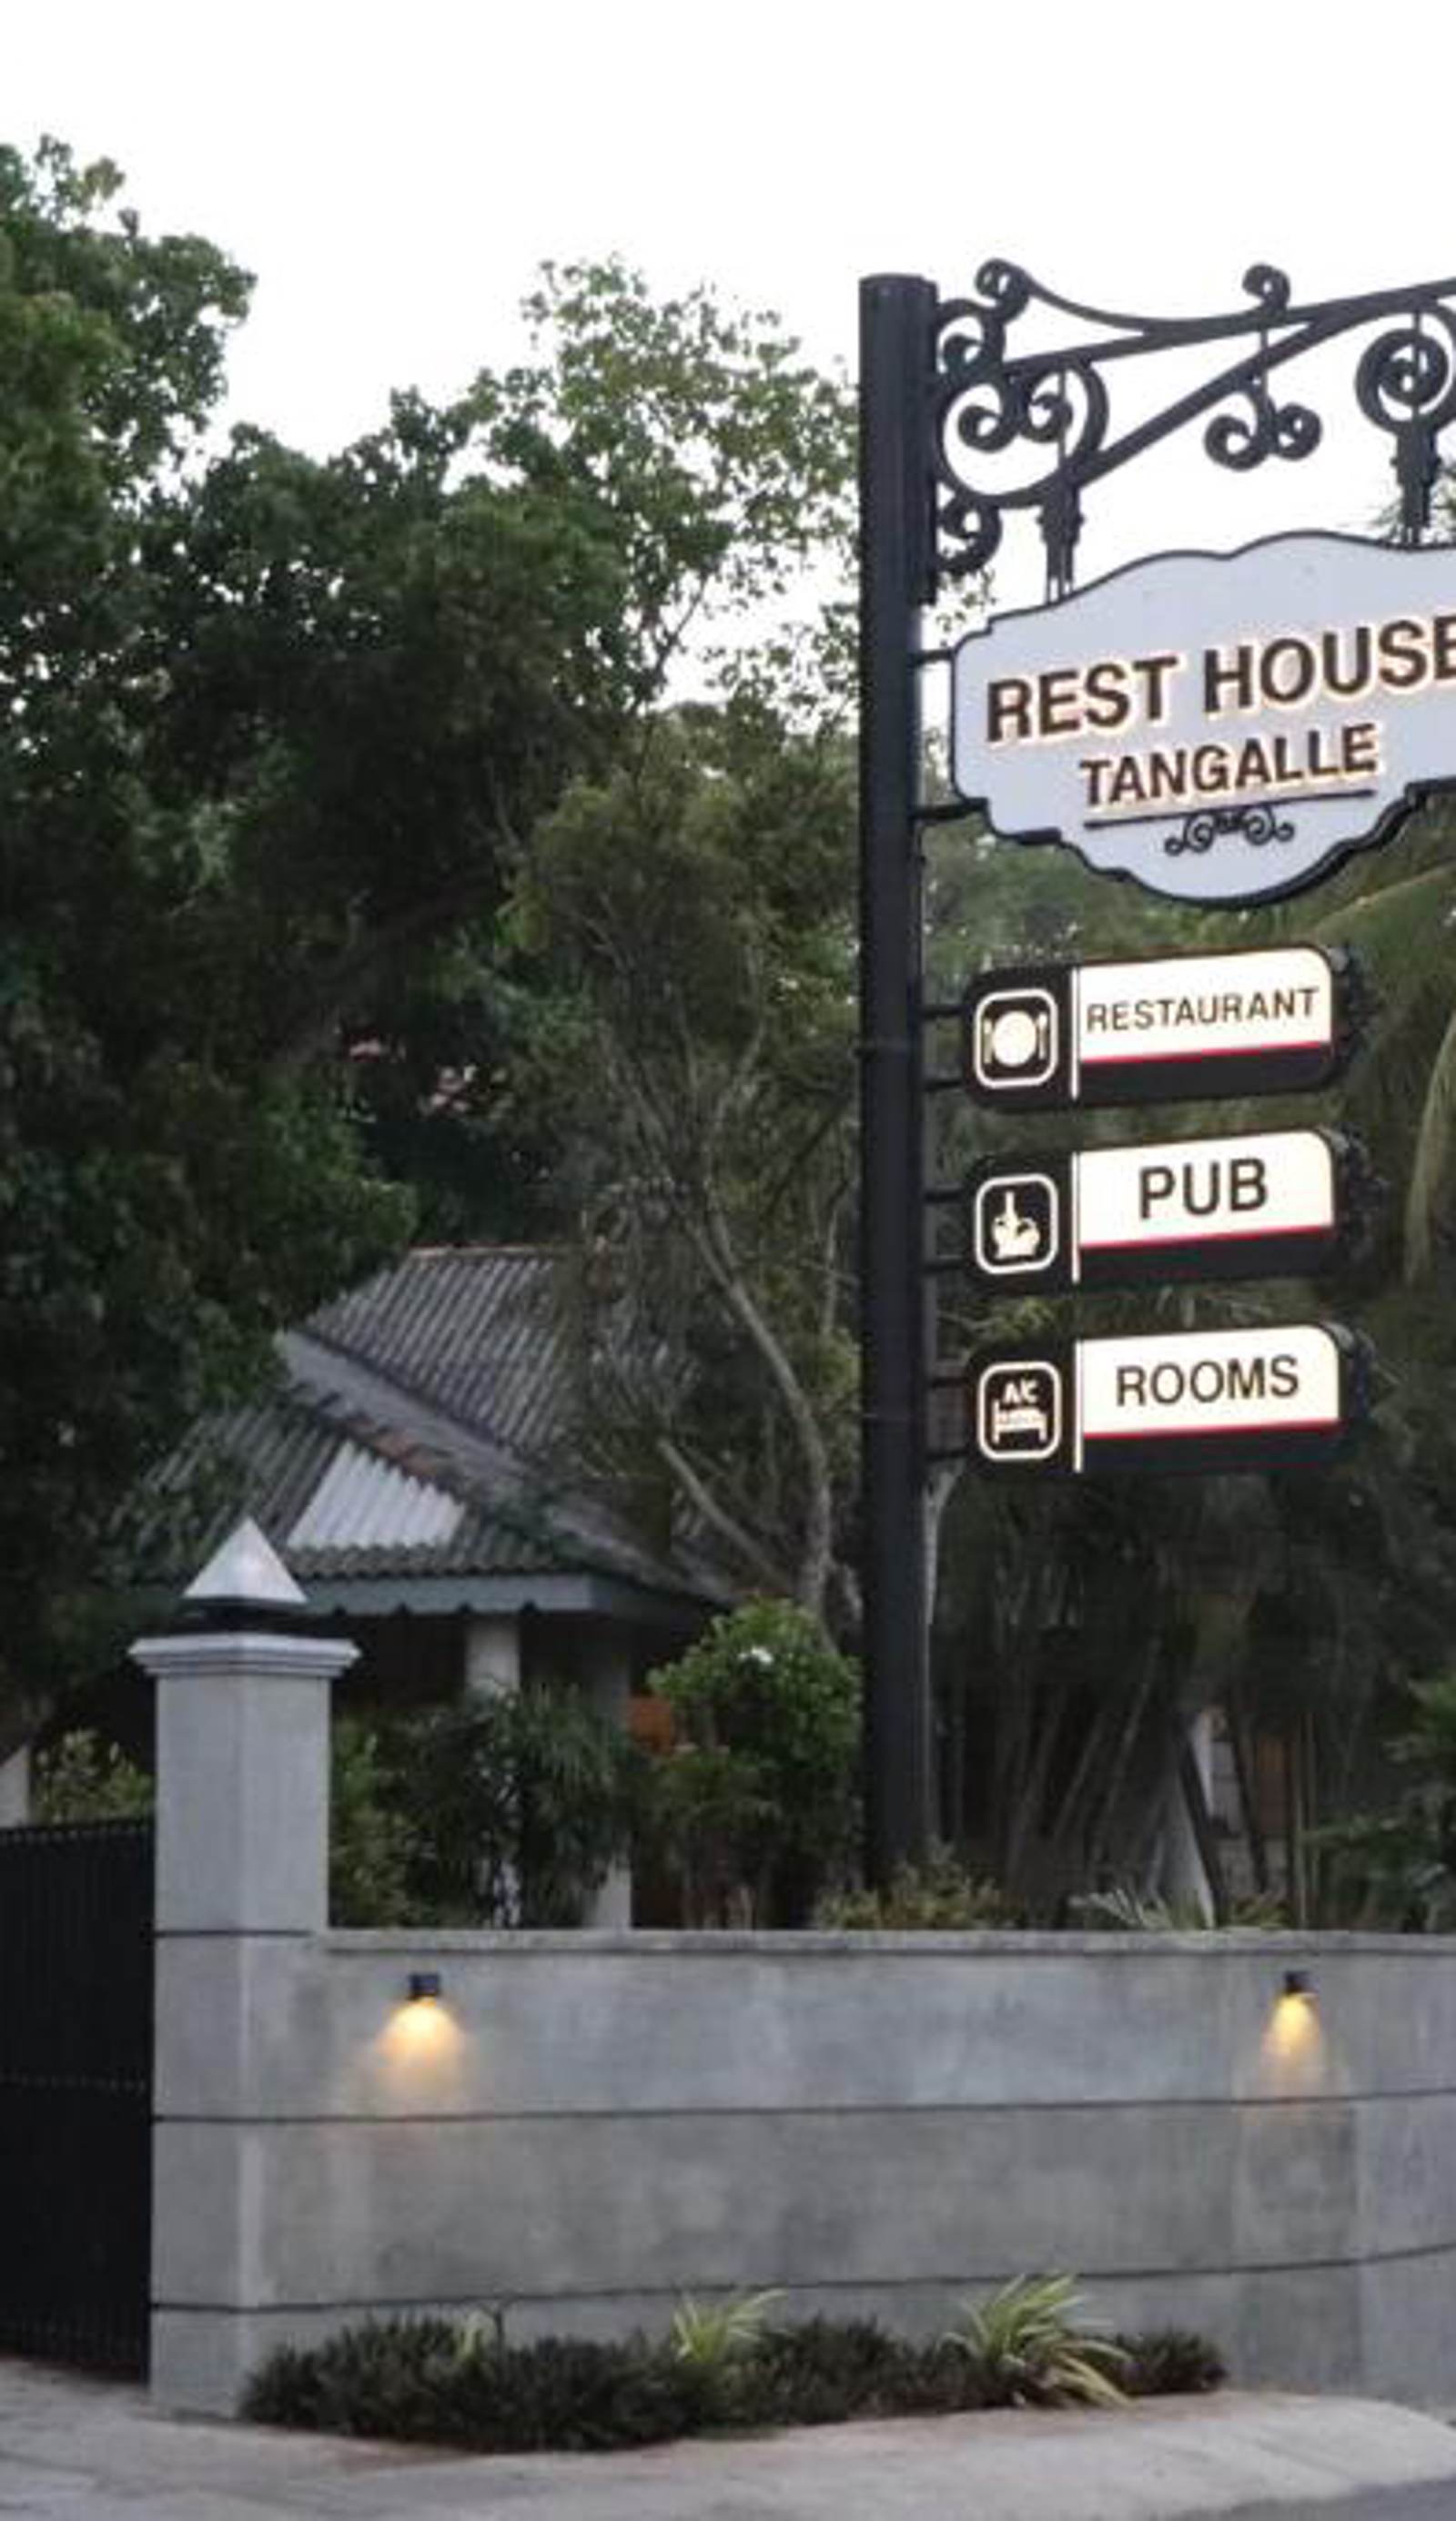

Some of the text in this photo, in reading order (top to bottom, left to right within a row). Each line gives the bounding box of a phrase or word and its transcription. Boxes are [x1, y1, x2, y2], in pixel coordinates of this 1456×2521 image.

[987, 656, 1178, 742] REST
[1080, 723, 1376, 805] TANGALLE
[1087, 987, 1320, 1032] RESTAURANT
[1138, 1159, 1268, 1220] PUB
[1116, 1355, 1299, 1406] ROOMS
